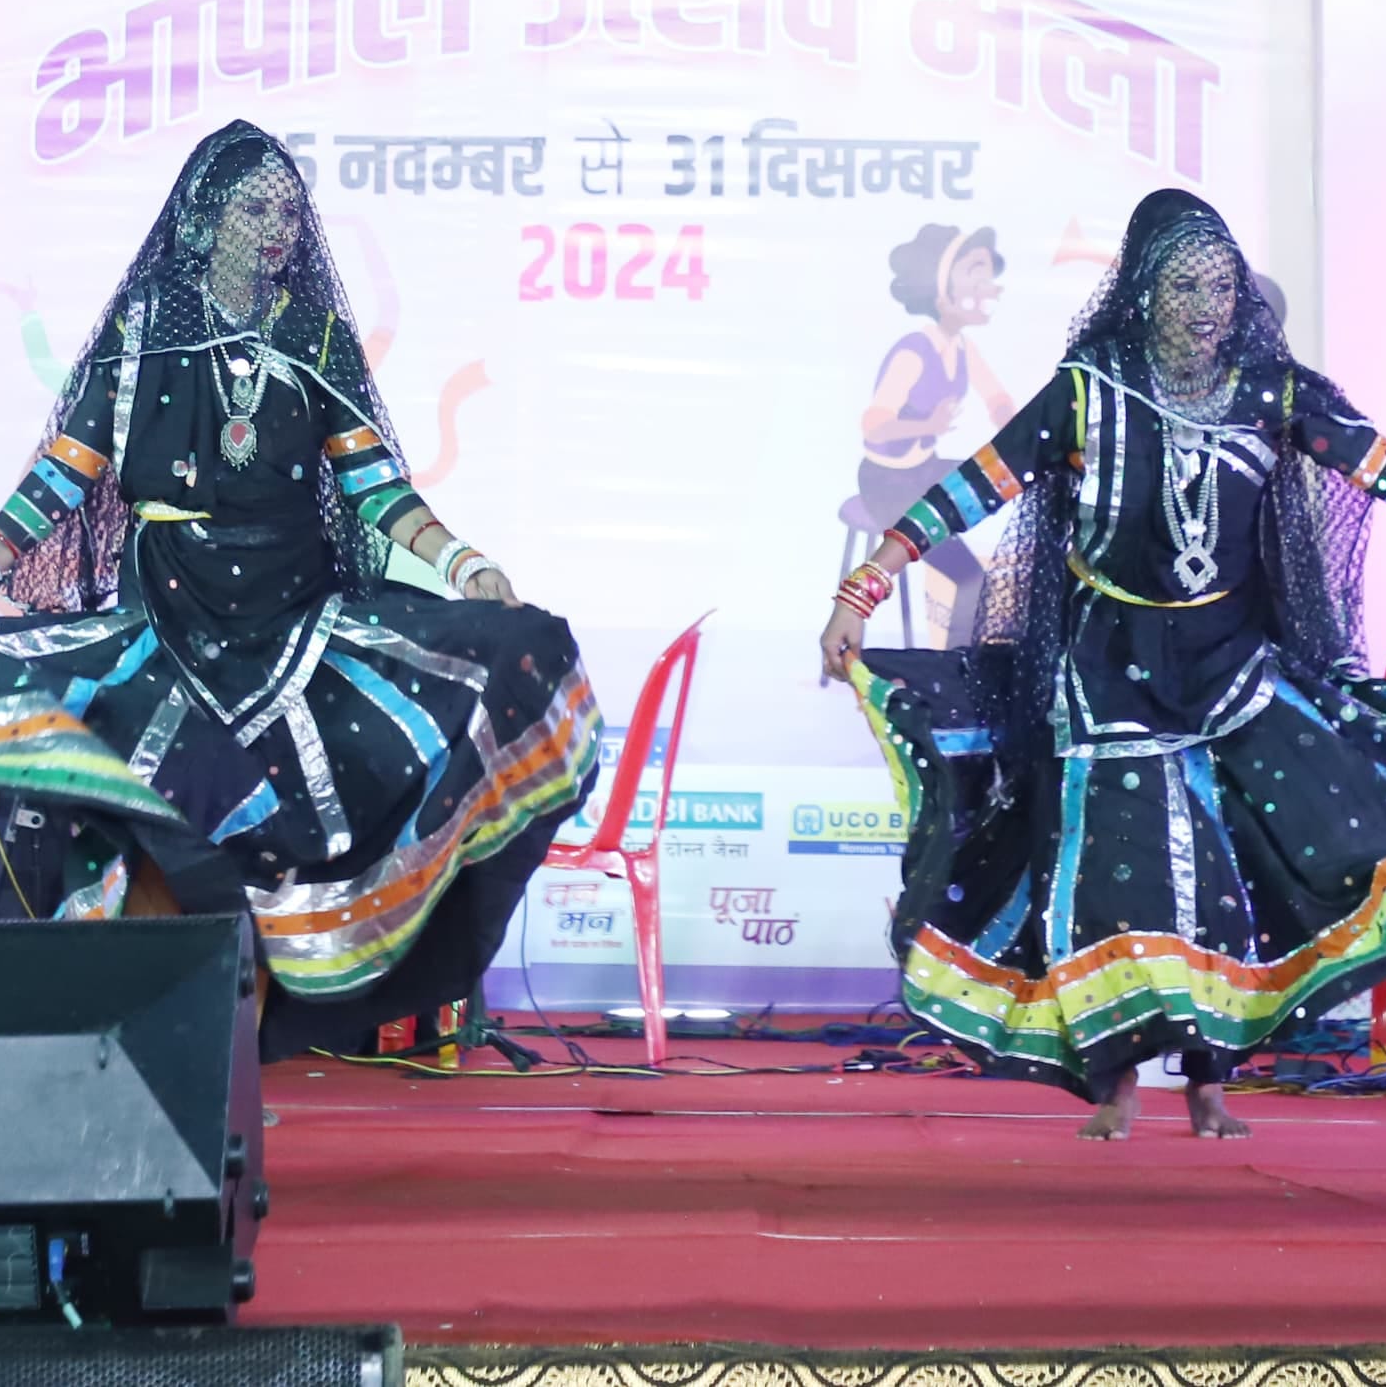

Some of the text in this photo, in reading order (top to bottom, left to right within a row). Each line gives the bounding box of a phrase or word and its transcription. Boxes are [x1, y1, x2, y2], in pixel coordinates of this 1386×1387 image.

[333, 134, 546, 197] नवम्बर
[575, 119, 631, 198] से
[663, 134, 725, 198] 31
[742, 118, 978, 201] दिसम्बर
[519, 223, 710, 301] 2024
[692, 803, 757, 823] BANK
[829, 812, 879, 828] UCO
[708, 887, 777, 926] पूजा
[741, 917, 800, 946] पाठ
